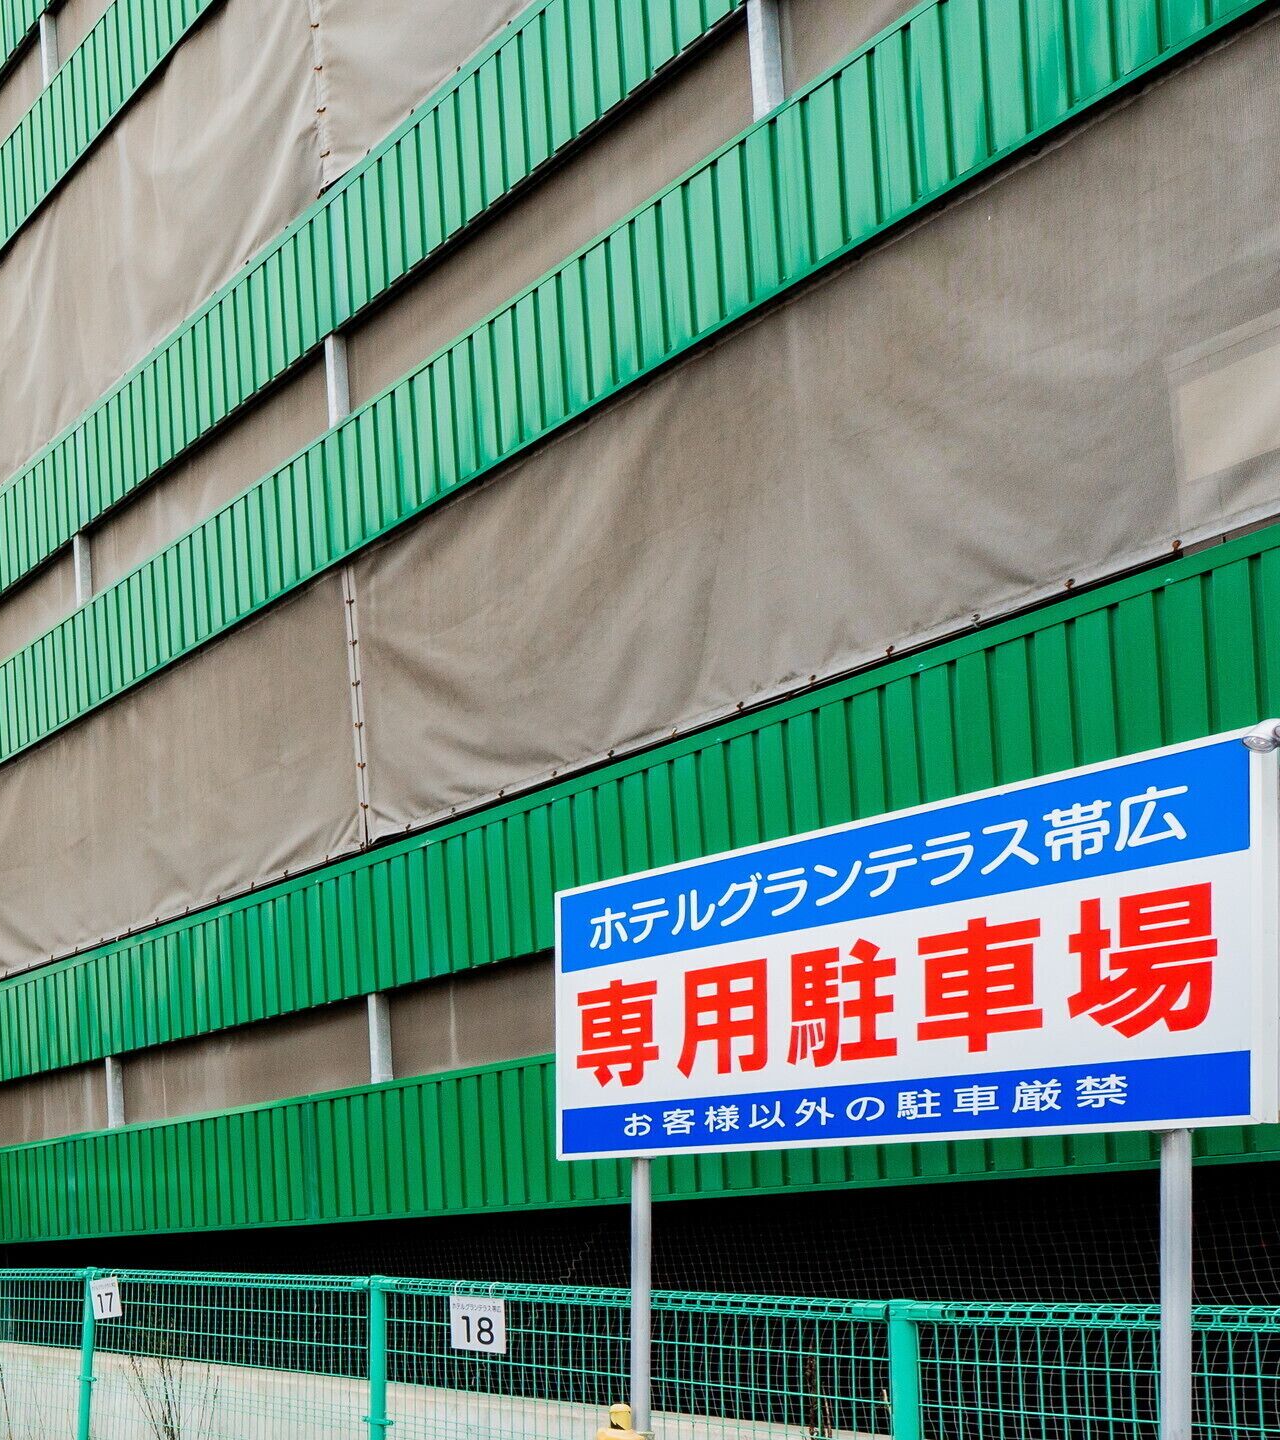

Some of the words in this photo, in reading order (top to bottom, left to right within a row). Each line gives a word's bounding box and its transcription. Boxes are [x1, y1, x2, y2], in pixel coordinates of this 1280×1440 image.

[589, 785, 1189, 951] ホテルグランテラス帯広
[576, 882, 1218, 1088] 専用駐車場
[623, 1073, 1129, 1137] お客様以外の駐車厳禁
[97, 1291, 114, 1314] 17
[461, 1315, 495, 1346] 18
